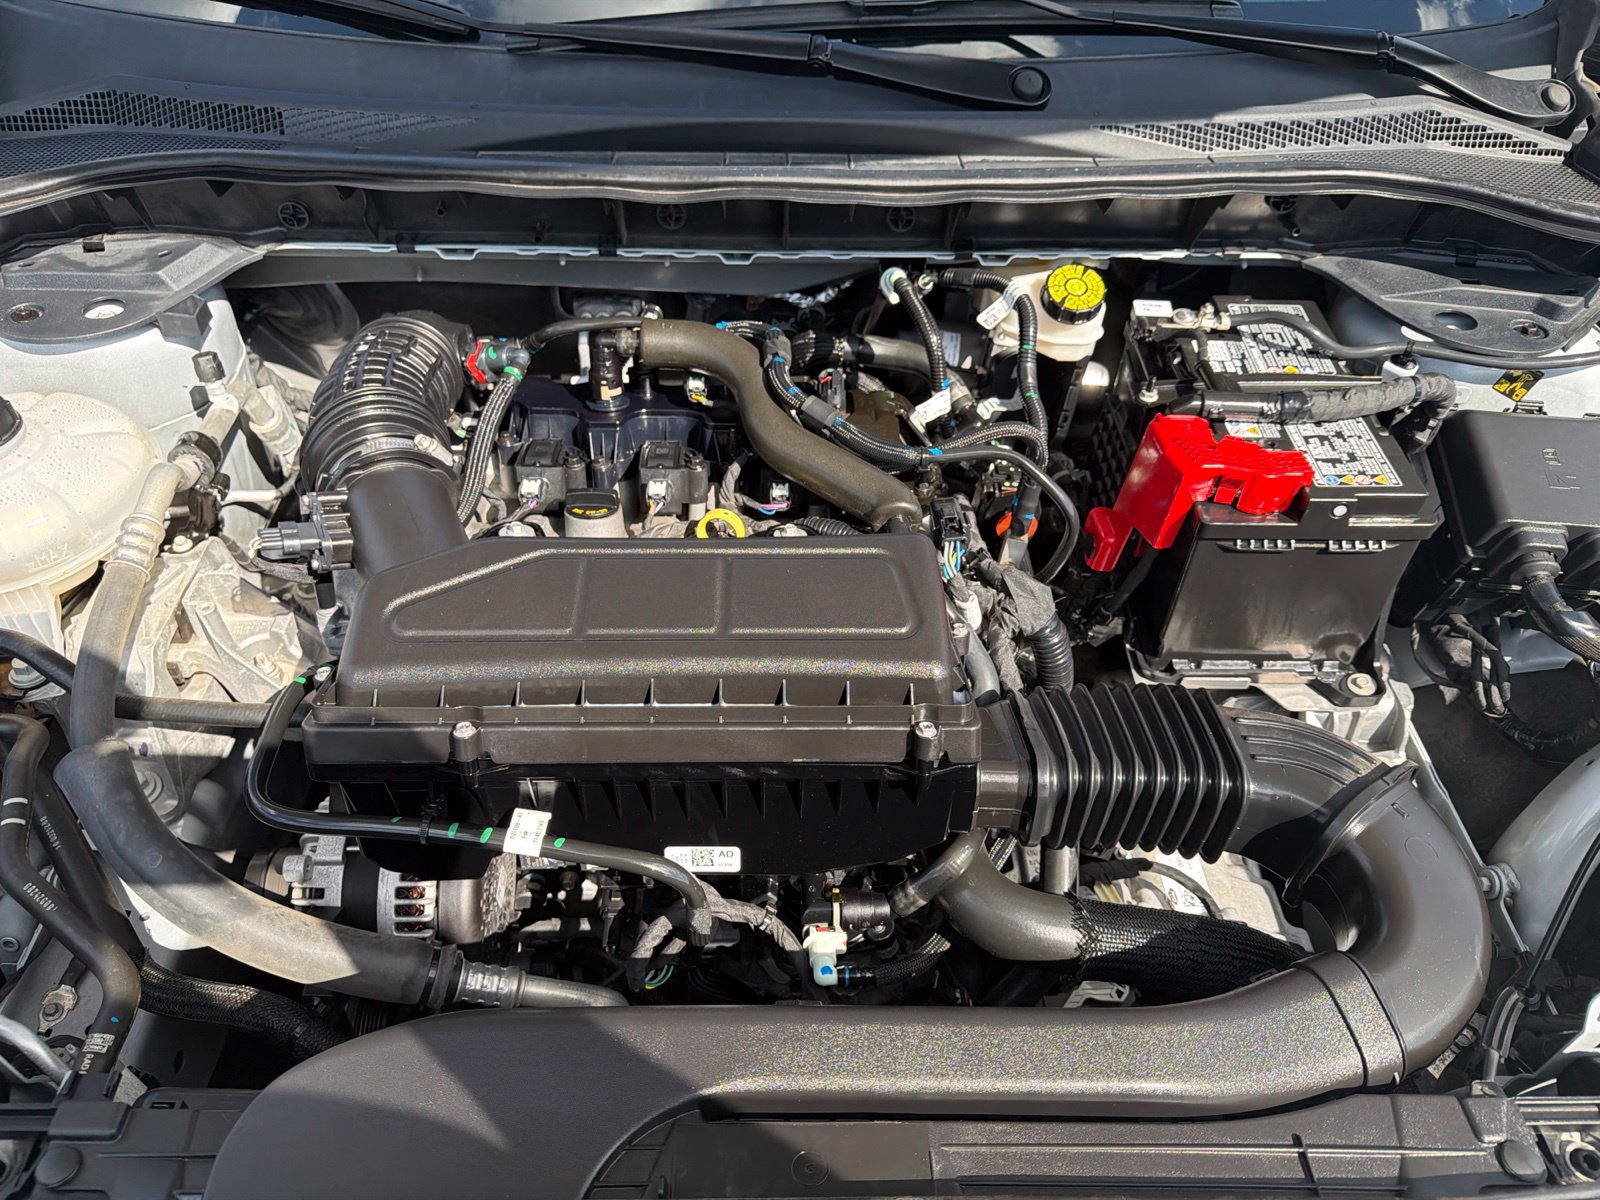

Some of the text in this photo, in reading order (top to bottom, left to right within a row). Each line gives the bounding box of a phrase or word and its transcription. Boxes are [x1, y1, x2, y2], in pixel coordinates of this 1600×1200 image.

[34, 542, 75, 567] MAX
[718, 850, 734, 858] AD
[81, 1054, 94, 1070] RAD
